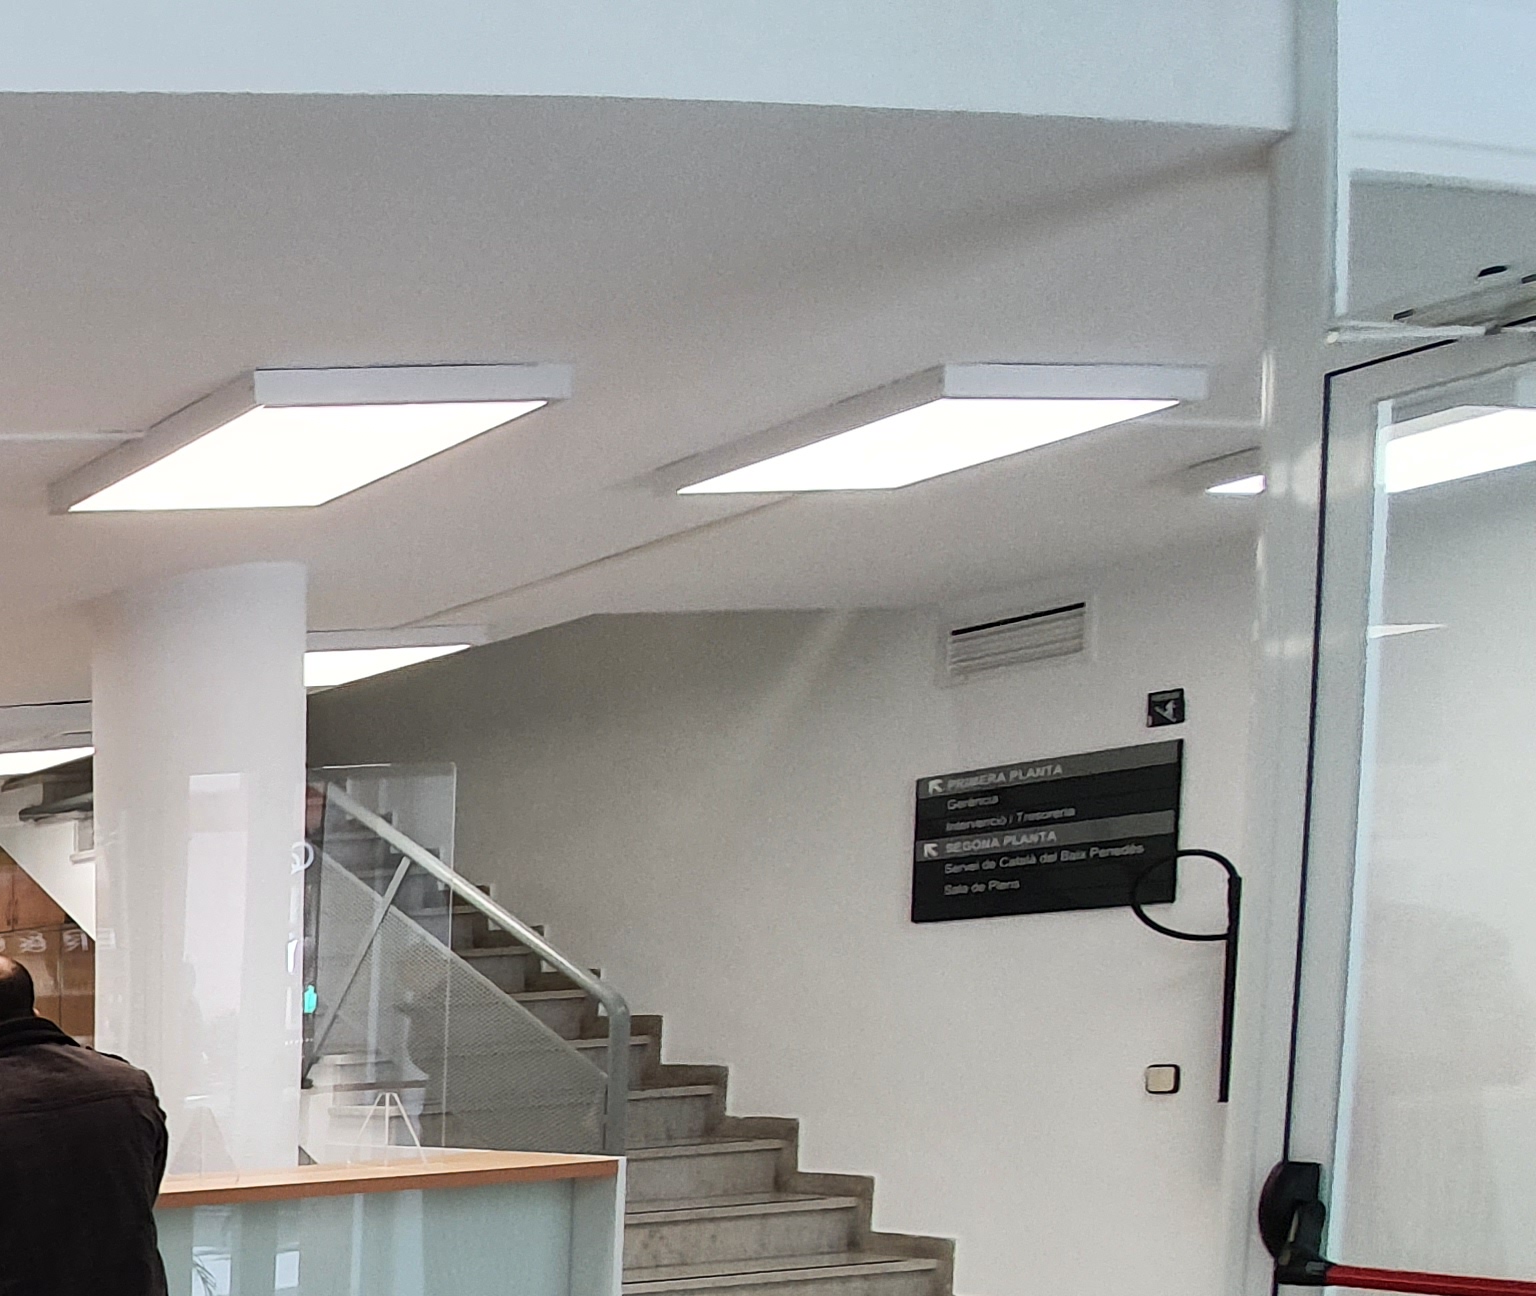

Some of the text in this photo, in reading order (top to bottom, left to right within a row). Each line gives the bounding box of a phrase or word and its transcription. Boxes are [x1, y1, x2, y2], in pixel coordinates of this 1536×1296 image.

[947, 764, 1063, 790] PRIMERA PLANTA
[946, 830, 1057, 853] SEGONA PLANTA
